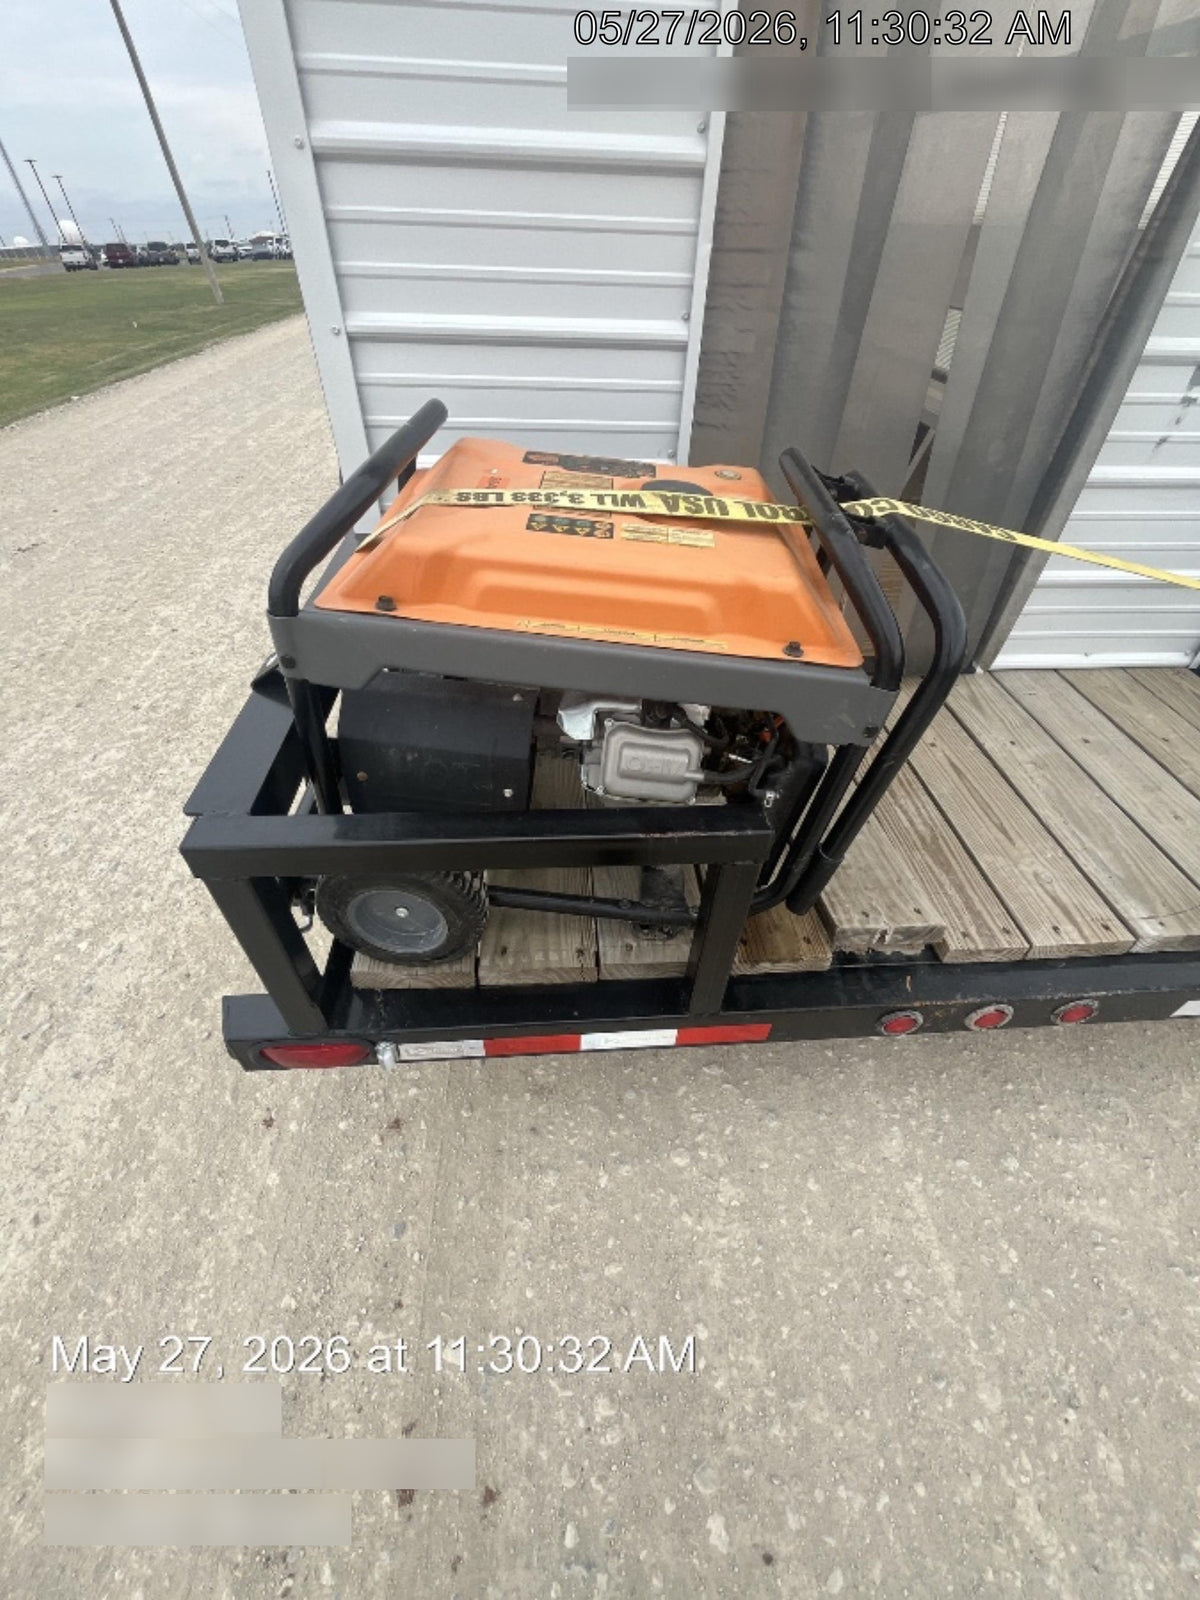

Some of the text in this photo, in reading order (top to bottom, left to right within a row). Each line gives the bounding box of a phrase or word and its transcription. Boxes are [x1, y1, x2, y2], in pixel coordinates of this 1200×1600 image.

[456, 491, 504, 503] LBS
[511, 490, 586, 505] 3,333
[591, 493, 647, 509] WLL
[654, 493, 730, 516] USA
